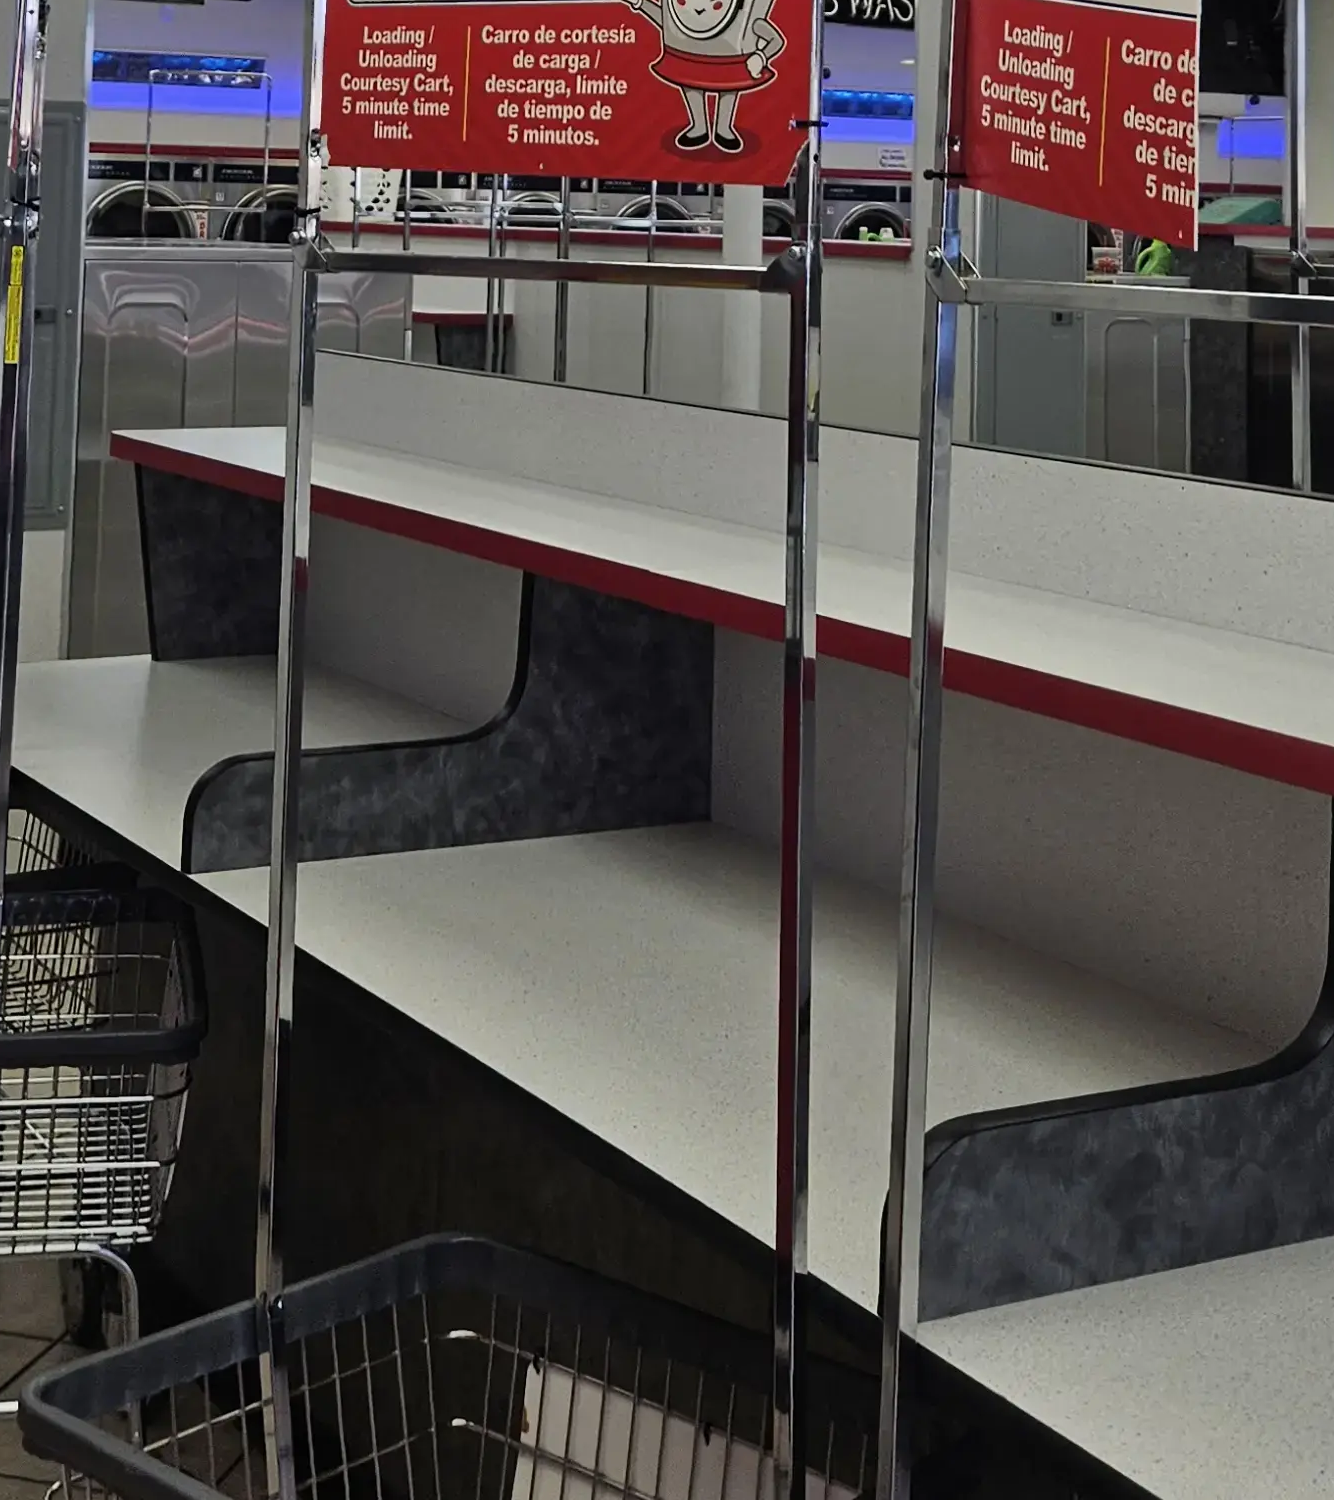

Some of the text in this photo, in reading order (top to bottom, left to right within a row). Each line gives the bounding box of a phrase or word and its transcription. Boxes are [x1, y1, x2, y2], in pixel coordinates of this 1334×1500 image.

[363, 25, 424, 47] Loading
[481, 23, 636, 45] Carro de cortesía
[1003, 20, 1063, 56] Loading
[358, 49, 437, 71] Unloading
[513, 51, 535, 69] de
[539, 54, 588, 75] carga
[1121, 39, 1171, 70] Carro
[997, 49, 1075, 88] Unloading
[340, 73, 454, 97] Courtesy Cart,
[485, 75, 628, 98] descarga, límite
[1153, 77, 1176, 103] de
[342, 97, 450, 116] 5 minute time
[981, 76, 1091, 123] Courtesy Cart,
[497, 101, 612, 124] de tiempo de
[373, 120, 413, 139] limit.
[507, 125, 599, 145] 5 minutos.
[980, 105, 1086, 149] 5 minute time
[1010, 141, 1049, 172] limit.
[1135, 141, 1158, 167] de
[1145, 173, 1157, 198] 5
